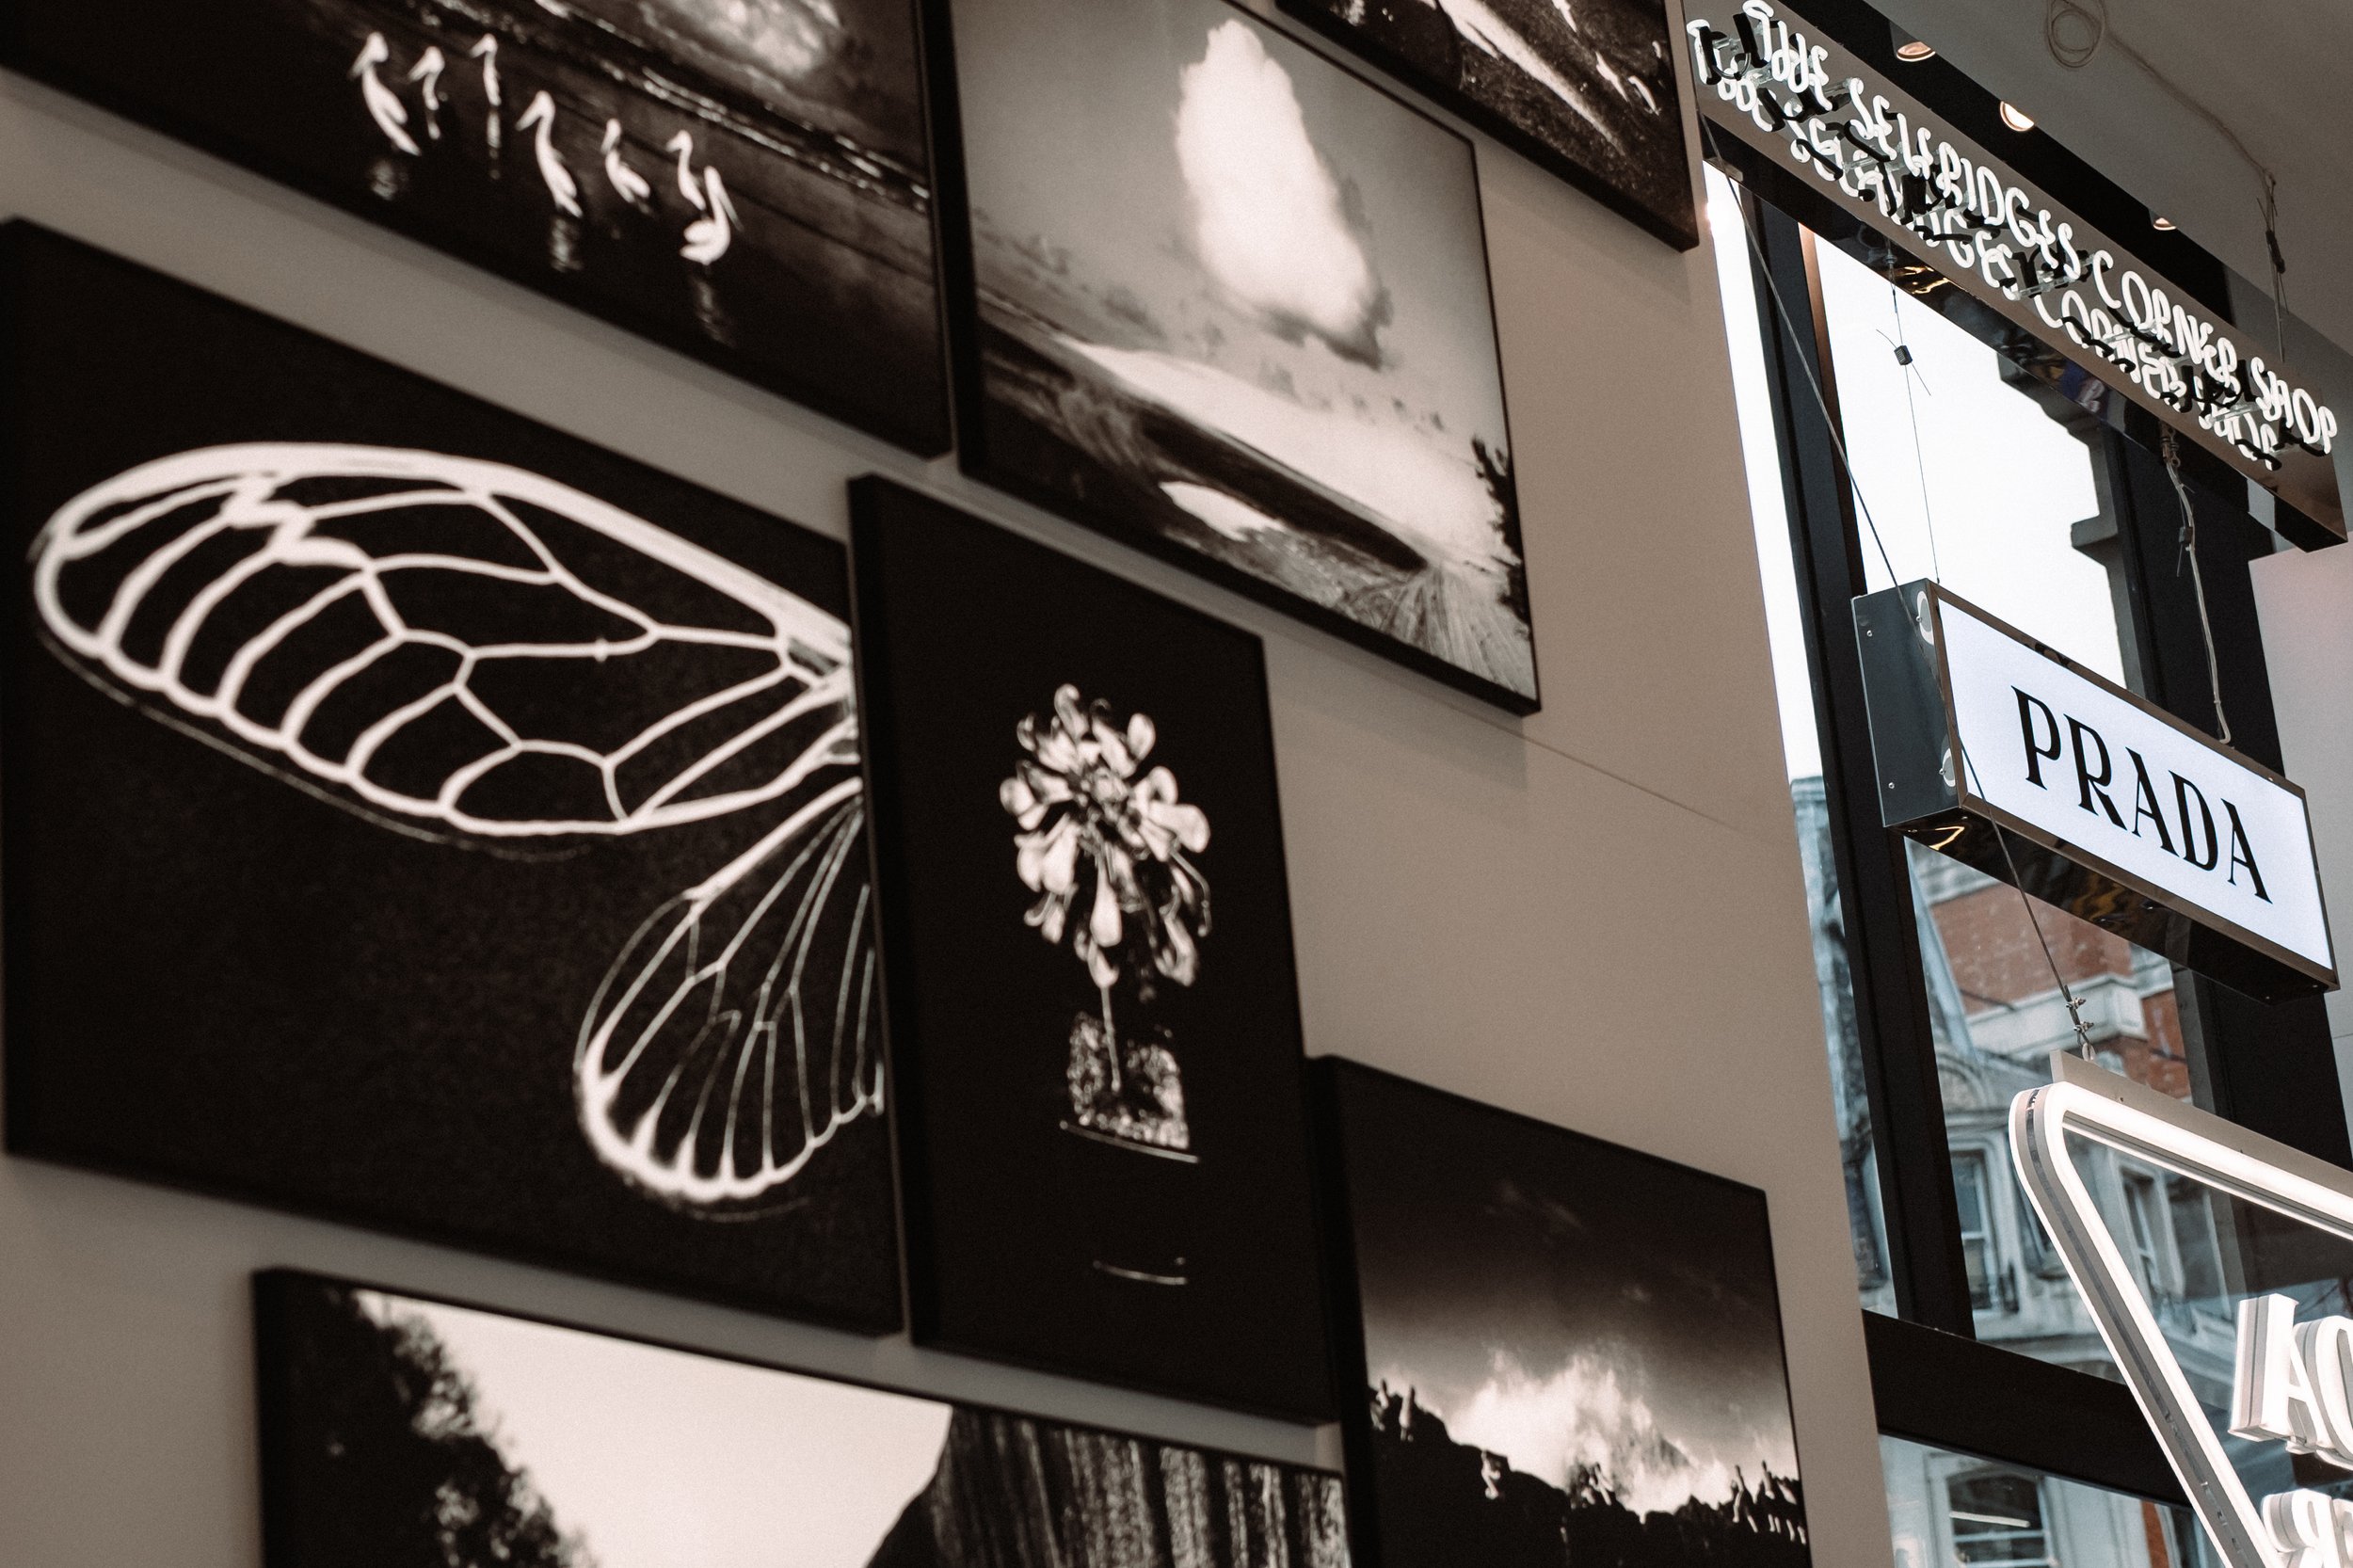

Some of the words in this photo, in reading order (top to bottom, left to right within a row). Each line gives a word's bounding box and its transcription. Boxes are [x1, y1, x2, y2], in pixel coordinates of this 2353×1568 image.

[1743, 0, 1833, 112] THE
[1849, 77, 2082, 280] SELFRIDGES
[2092, 249, 2242, 394] CORNER
[2250, 356, 2338, 455] SHOP
[2010, 684, 2274, 904] PRADA
